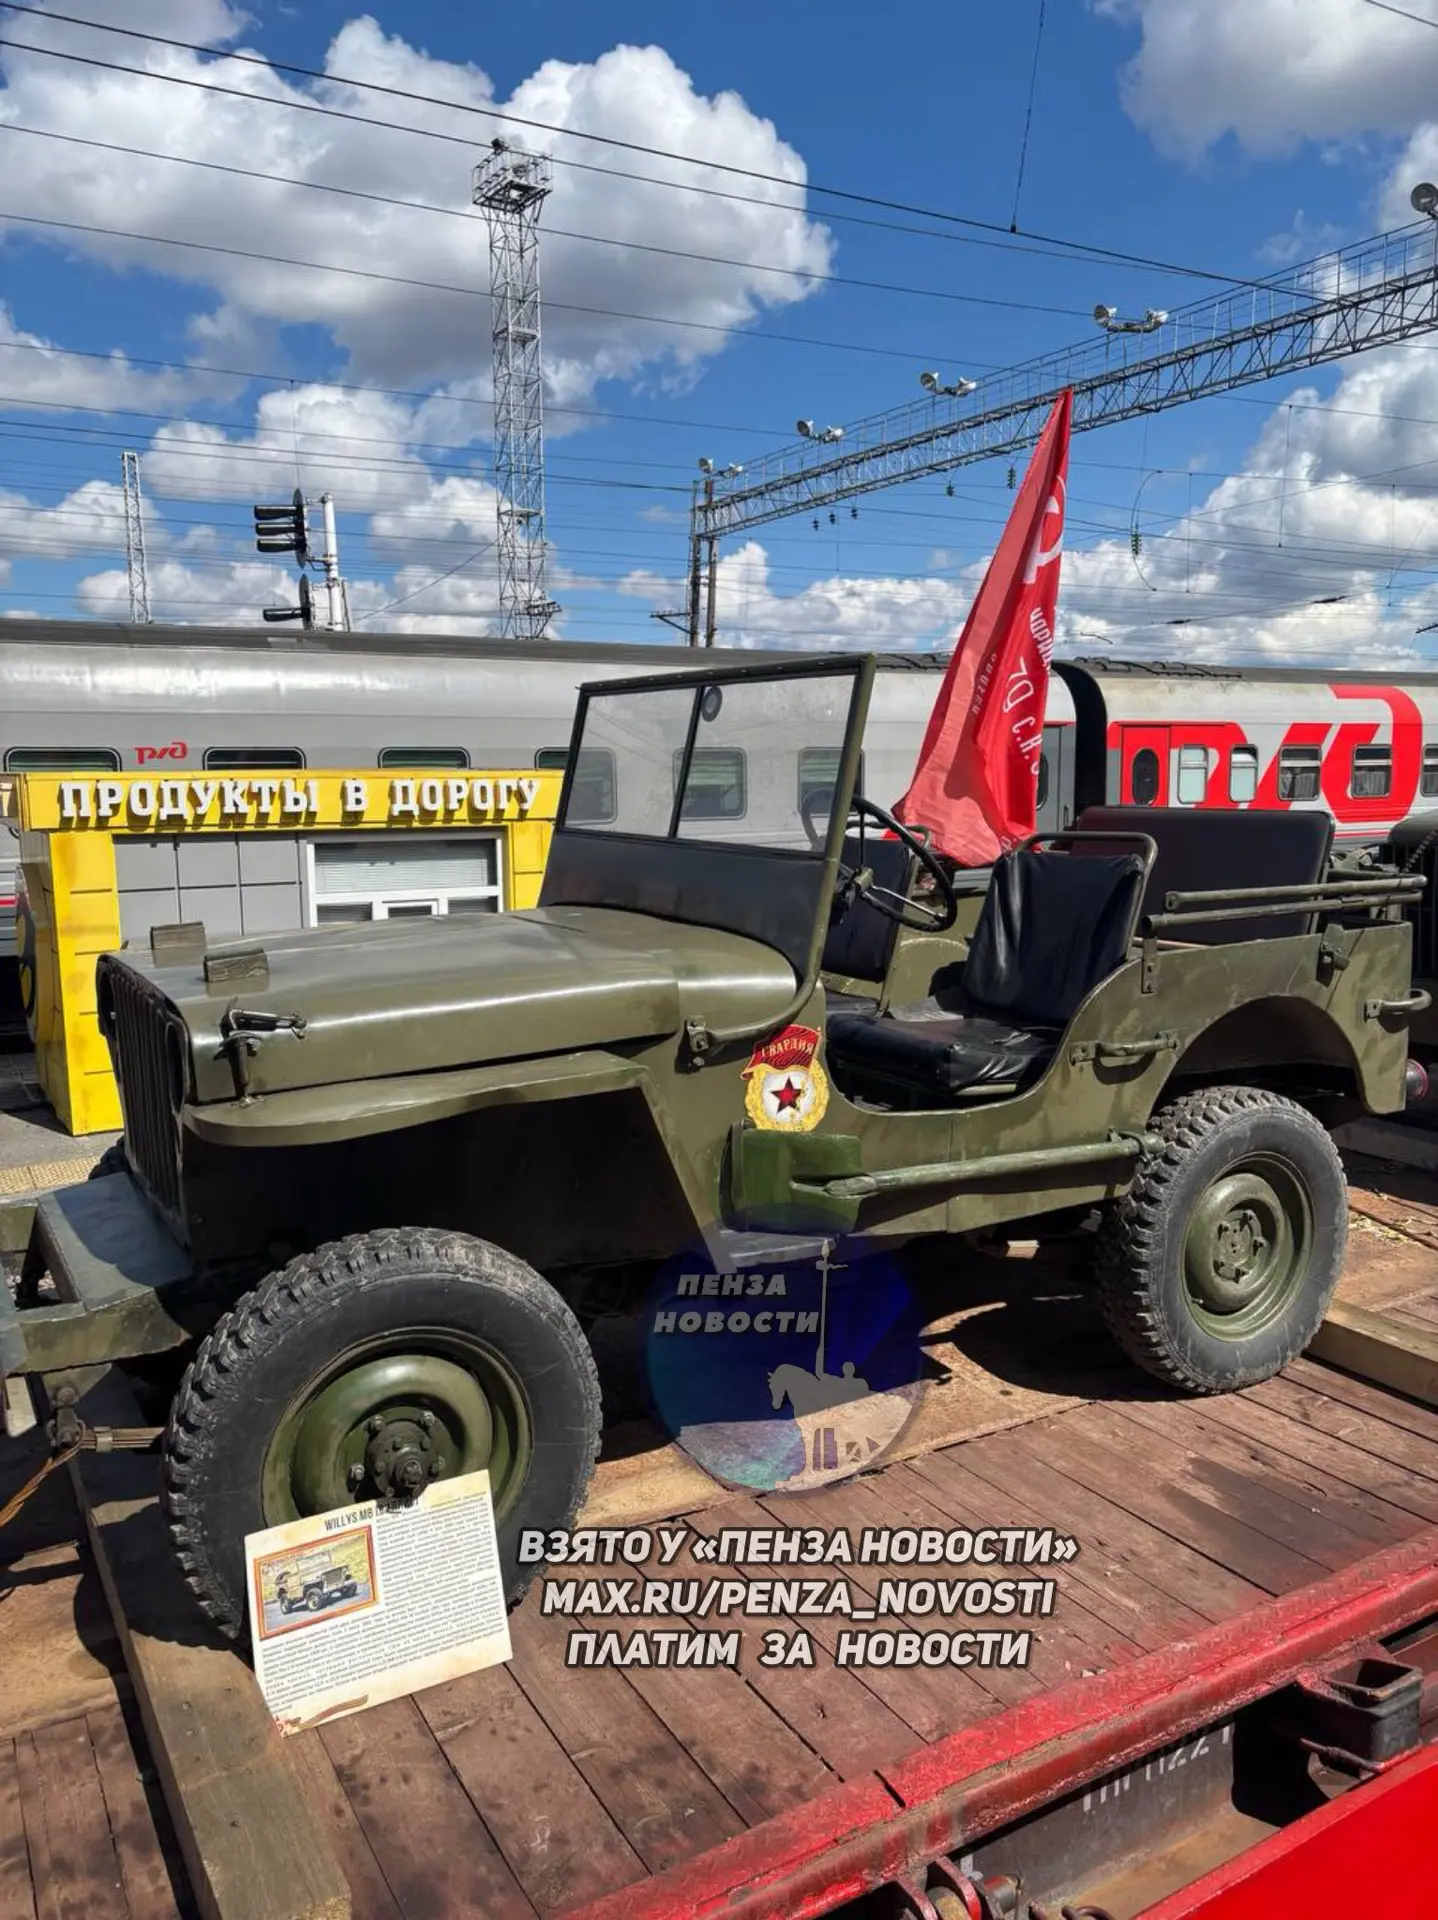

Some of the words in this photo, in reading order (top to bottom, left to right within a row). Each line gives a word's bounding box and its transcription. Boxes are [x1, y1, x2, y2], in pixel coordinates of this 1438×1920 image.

[59, 779, 319, 821] ПРОДУКТЫ
[343, 779, 368, 812] В
[389, 778, 541, 816] ДОРОГУ
[761, 1038, 815, 1057] ГВАРДИЯ
[324, 1510, 358, 1531] WILLYS
